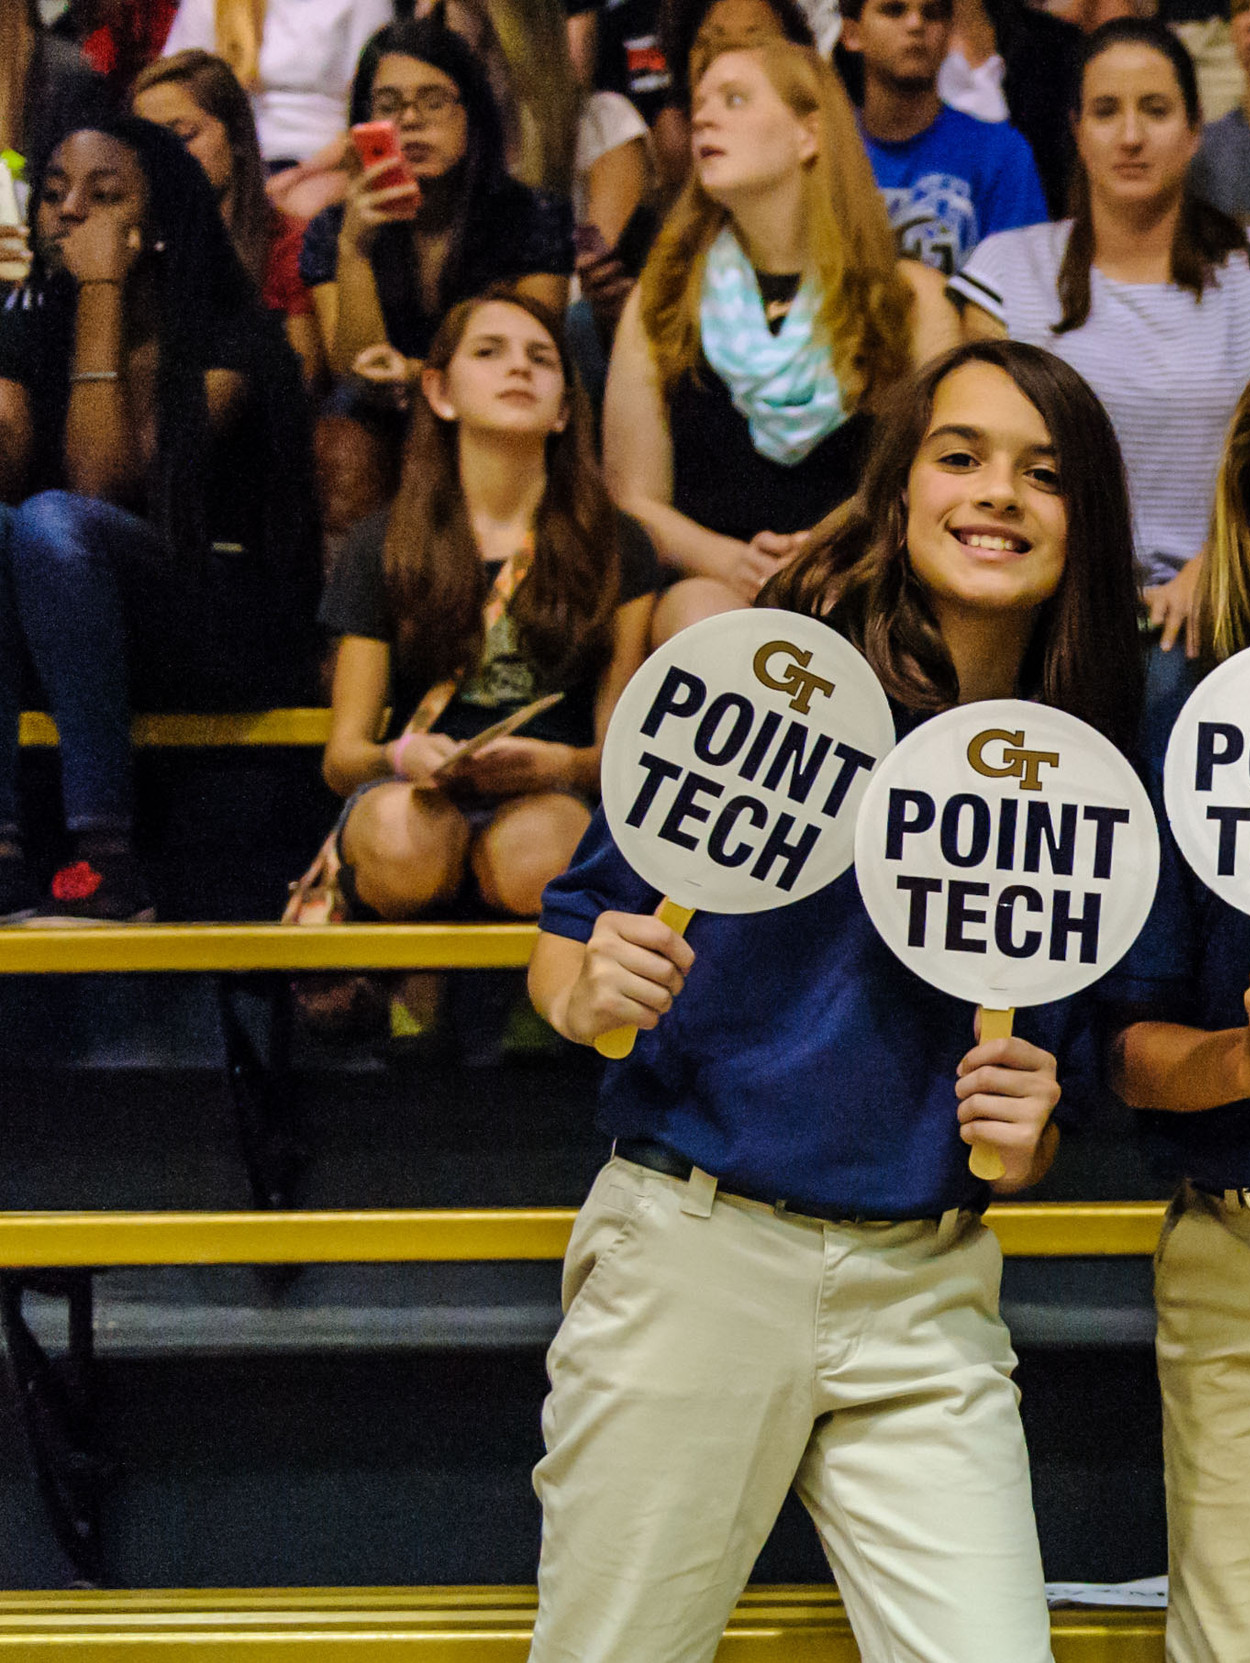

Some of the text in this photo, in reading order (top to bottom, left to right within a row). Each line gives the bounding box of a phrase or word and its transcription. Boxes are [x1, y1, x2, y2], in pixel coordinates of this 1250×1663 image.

[752, 640, 835, 715] GT
[640, 666, 877, 819] POINT
[967, 729, 1060, 792] GT
[625, 752, 822, 892] TECH
[885, 788, 1130, 880] POINT
[897, 875, 1102, 964] TECH
